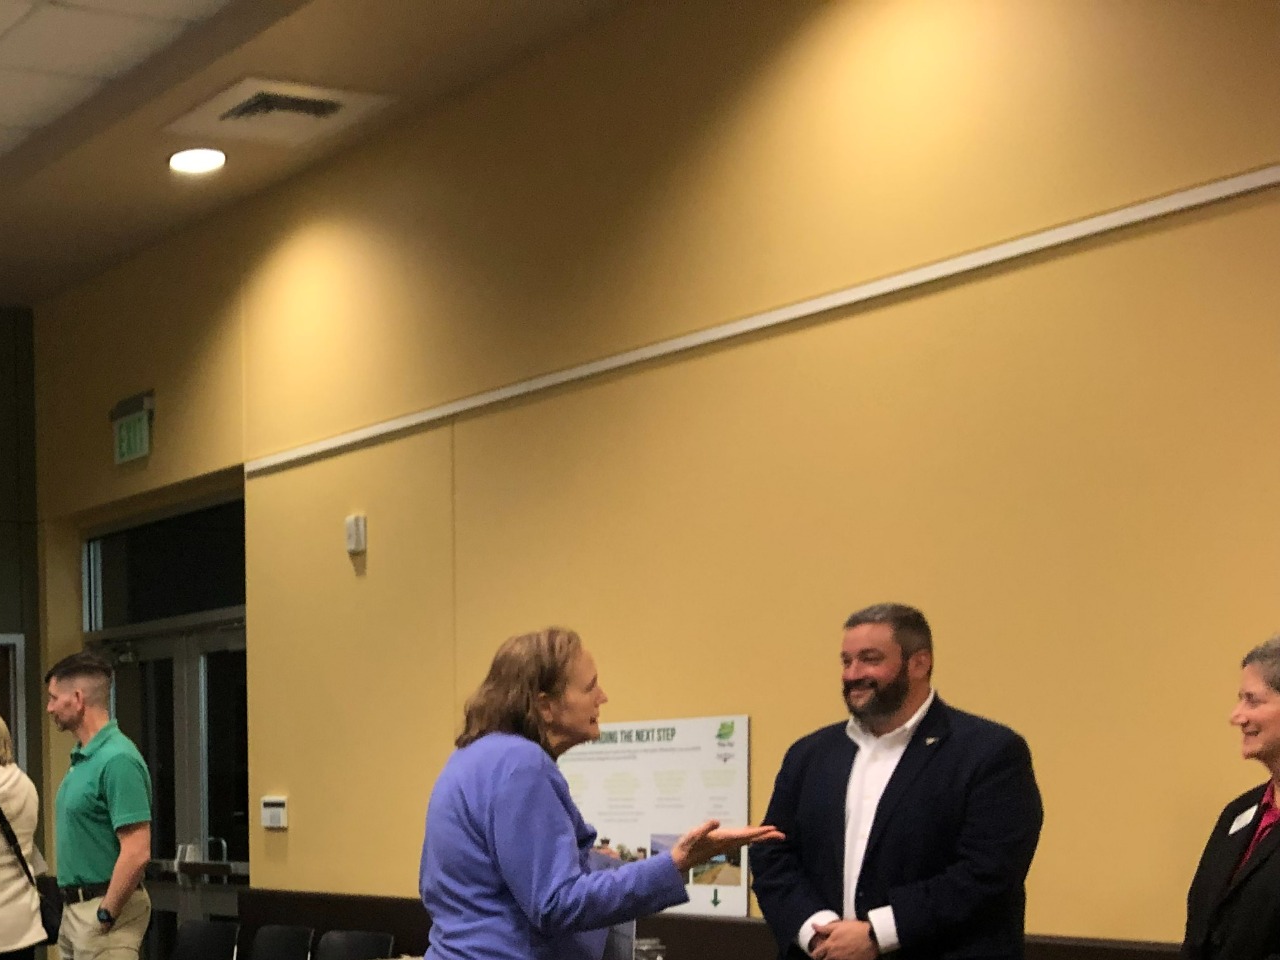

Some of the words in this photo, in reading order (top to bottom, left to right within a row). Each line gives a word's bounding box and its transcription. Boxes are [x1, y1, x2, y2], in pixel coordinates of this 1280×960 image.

[620, 730, 634, 744] THE
[635, 729, 655, 743] NEXT
[657, 727, 676, 742] STEP
